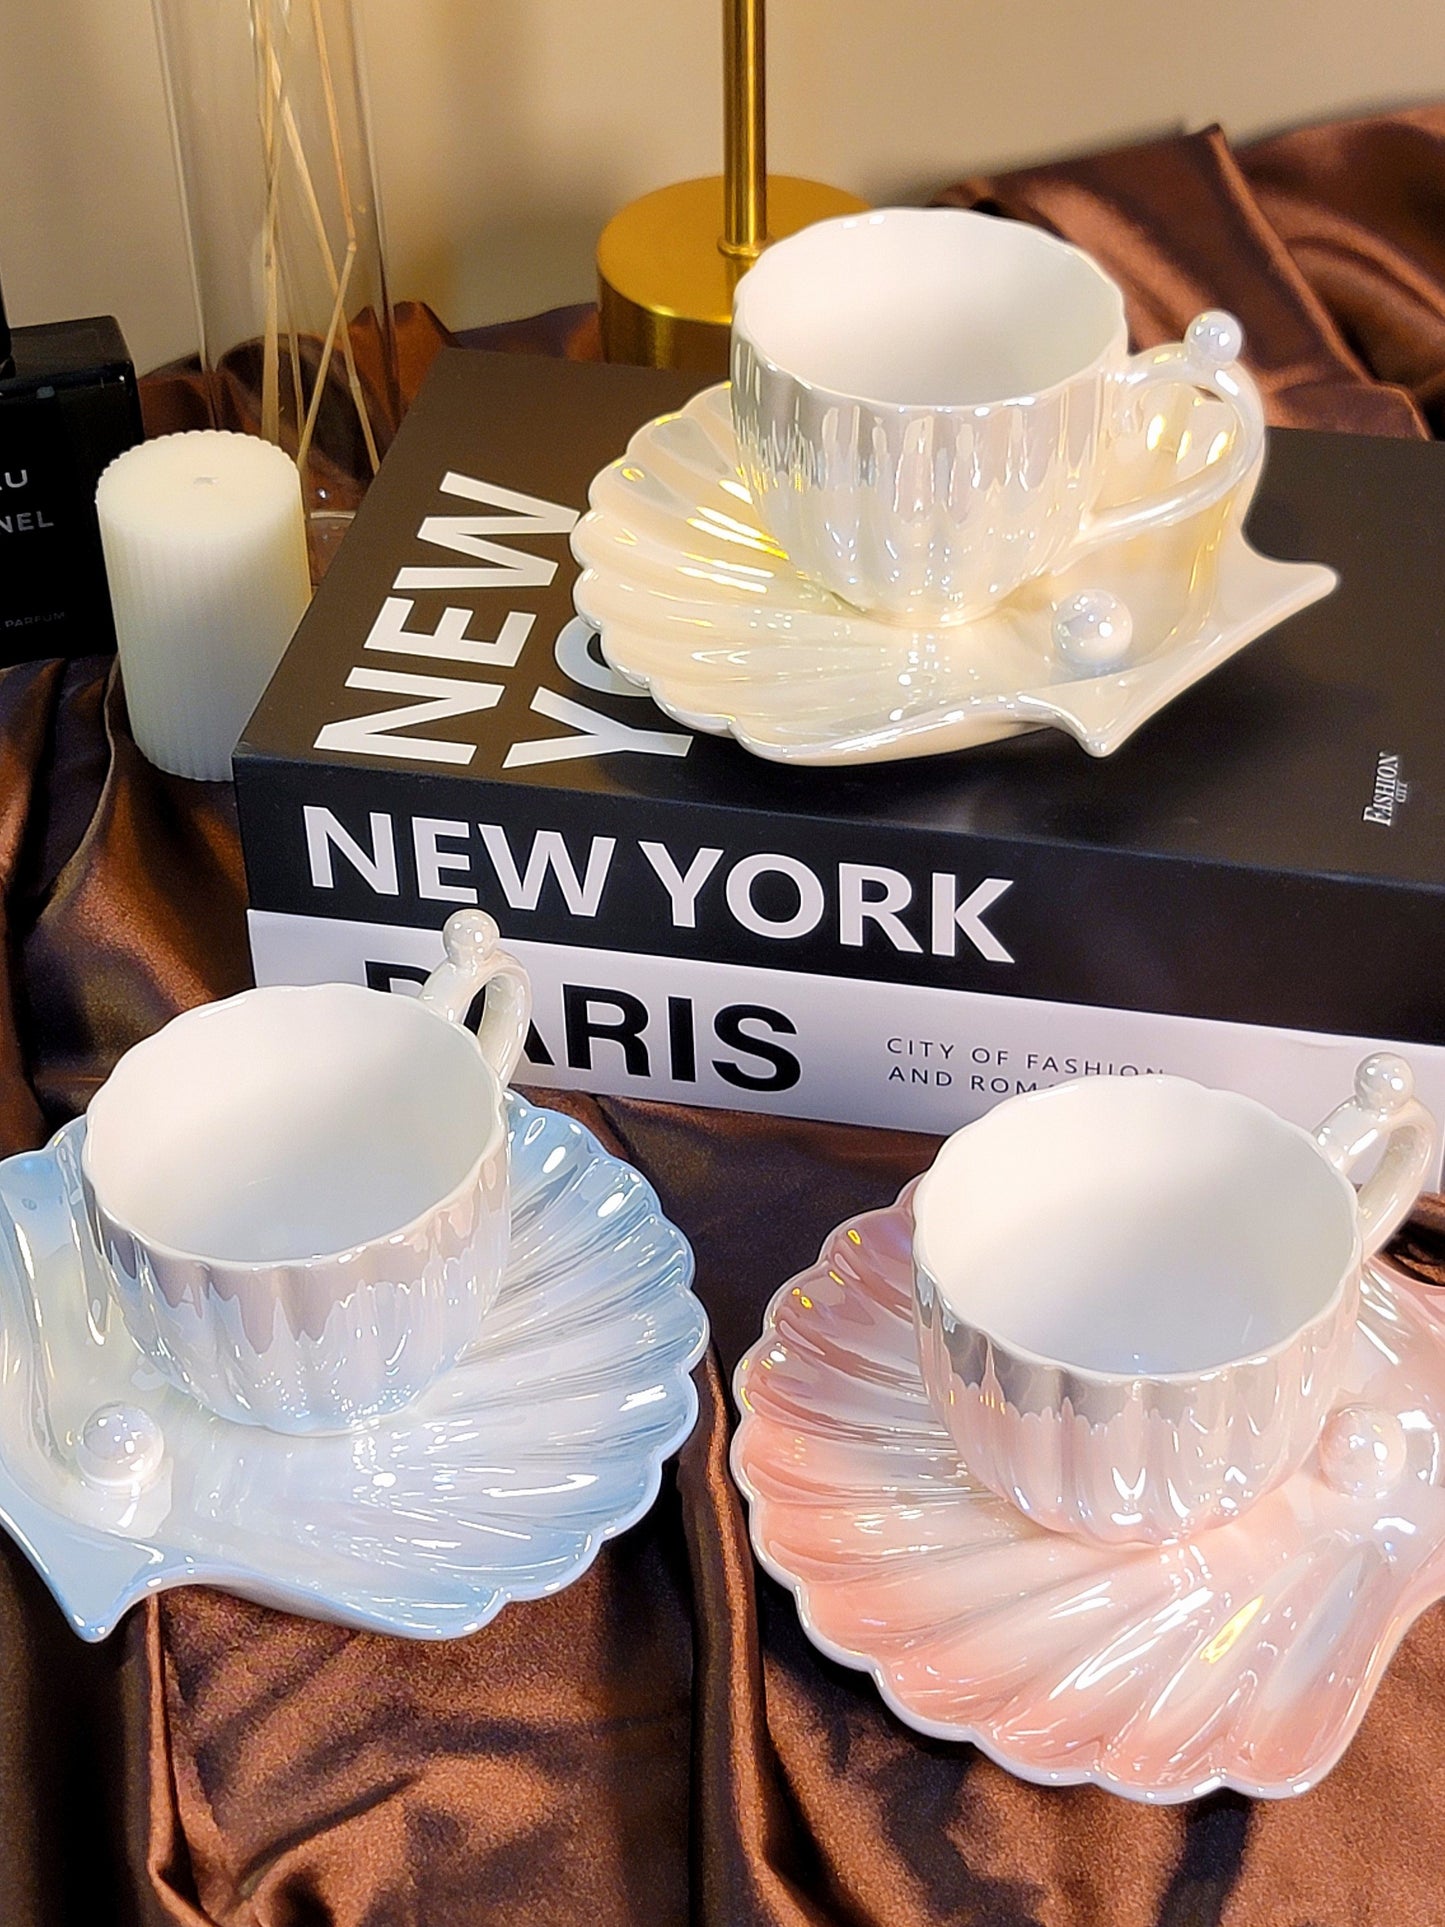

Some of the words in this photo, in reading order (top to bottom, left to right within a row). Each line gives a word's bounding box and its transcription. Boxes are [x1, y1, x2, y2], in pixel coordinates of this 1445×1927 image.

[0, 469, 28, 490] U
[312, 471, 580, 765] NEW
[502, 614, 694, 769] Y
[302, 805, 616, 918] NEW
[638, 840, 1016, 964] YORK
[886, 1038, 955, 1060] CITY
[971, 1047, 1009, 1066] OF
[888, 1066, 953, 1087] AND
[970, 1075, 1055, 1096] ROM
